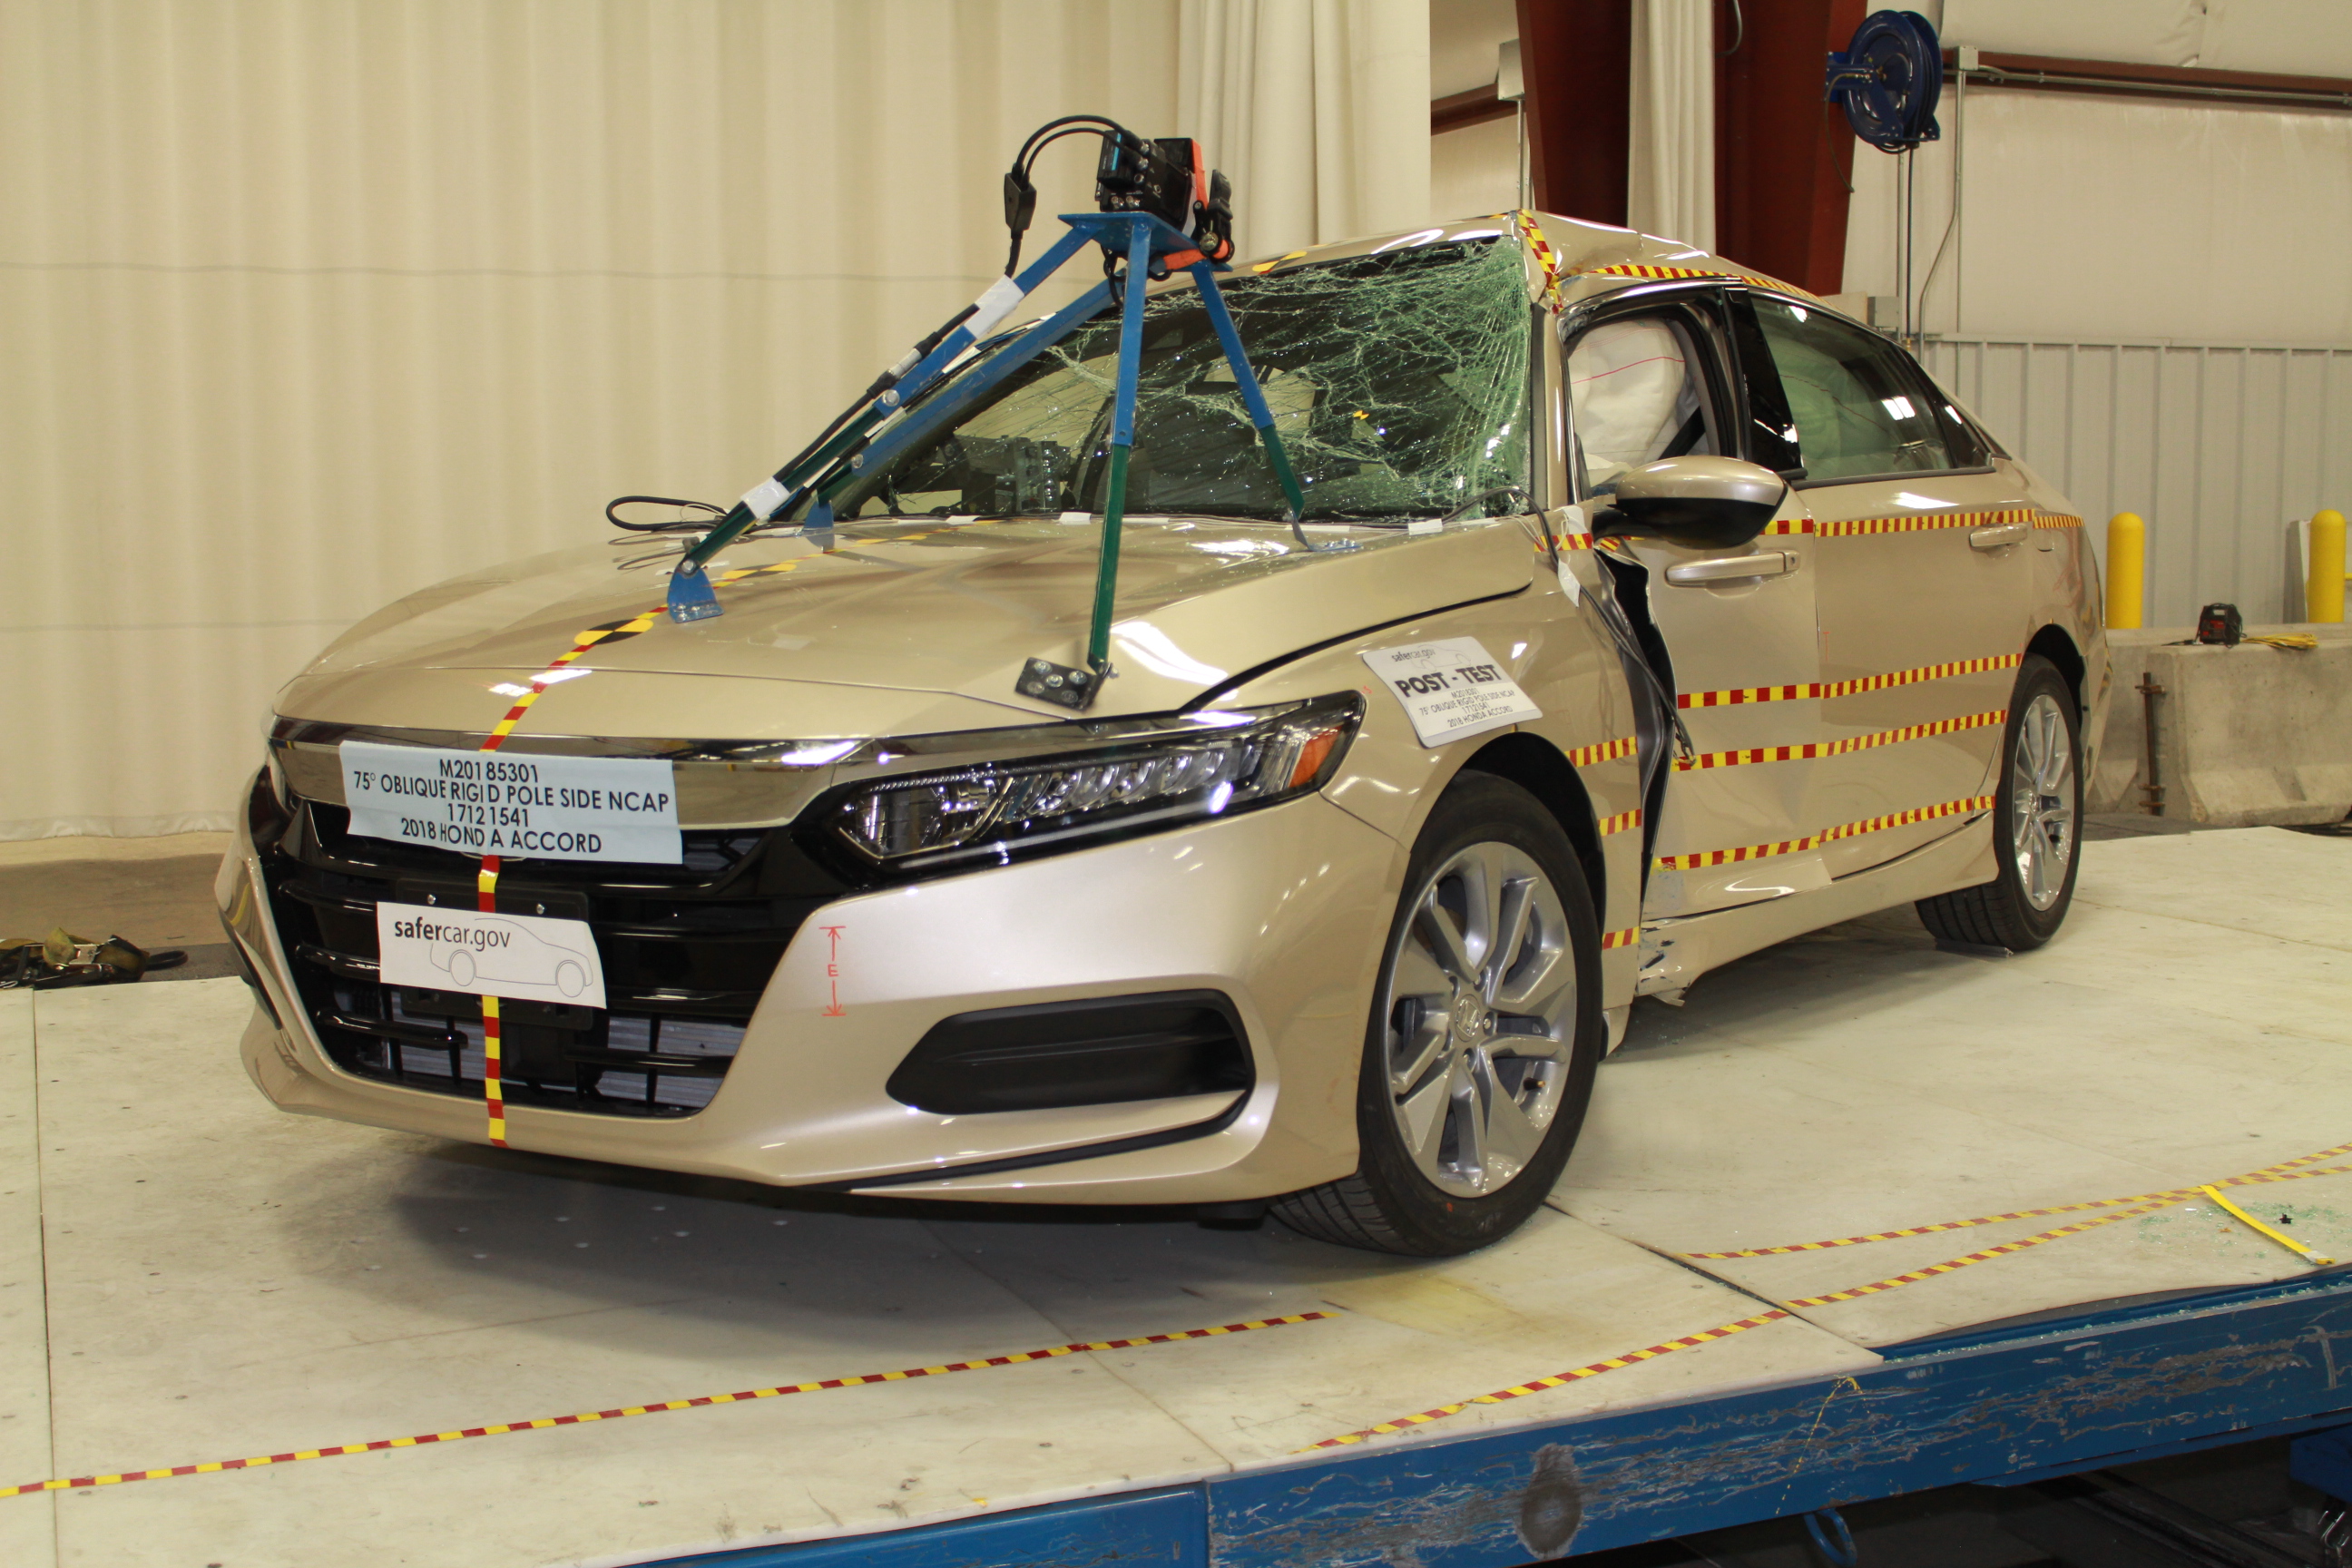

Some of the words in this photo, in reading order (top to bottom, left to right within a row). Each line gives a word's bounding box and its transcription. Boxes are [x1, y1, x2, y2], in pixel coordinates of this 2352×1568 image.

[1394, 671, 1451, 698] POST
[1455, 664, 1503, 685] TEST
[1430, 700, 1458, 713] OBLIQUE
[1456, 696, 1475, 707] RIGID
[1473, 692, 1490, 702] POLE
[1499, 690, 1515, 698] NCAP
[1447, 716, 1464, 728] 2018
[1462, 710, 1488, 724] HONDA
[1487, 705, 1514, 717] ACCORD
[439, 759, 540, 783] M20185301
[380, 774, 446, 799] OBLIQUE
[450, 781, 500, 803] RIGID
[507, 785, 554, 807] POLE
[560, 789, 602, 809] SIDE
[609, 791, 670, 813] NCAP
[447, 803, 530, 828] 17121541
[401, 818, 437, 840] 2018
[440, 823, 505, 848] HONDA
[510, 829, 602, 854] ACCORD
[395, 916, 511, 952] safercar.gov
[828, 964, 839, 977] E
